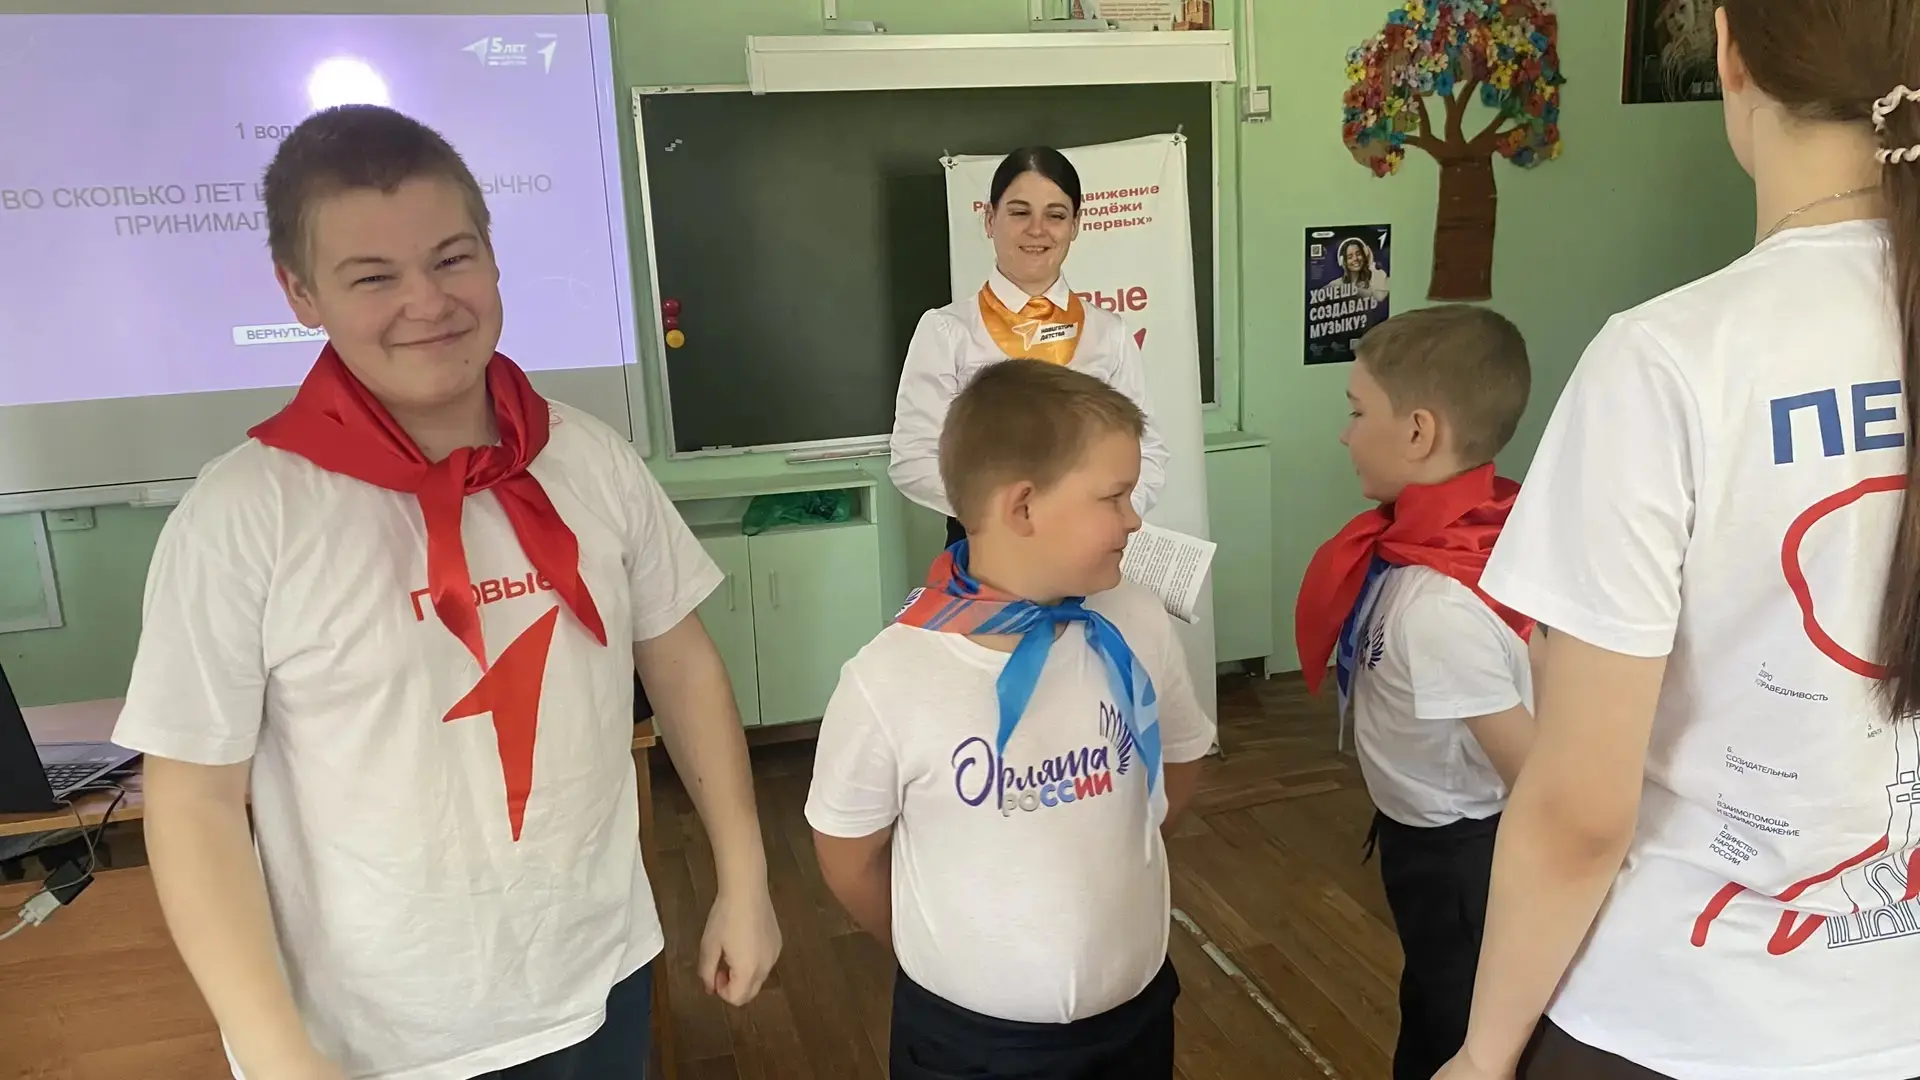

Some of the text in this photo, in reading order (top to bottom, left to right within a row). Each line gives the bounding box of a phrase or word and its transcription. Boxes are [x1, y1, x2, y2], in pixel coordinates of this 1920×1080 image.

[490, 36, 503, 53] 5
[236, 122, 246, 140] 1
[1, 189, 44, 210] ВО
[52, 183, 186, 209] СКОЛЬКО
[194, 182, 246, 204] ЛЕТ
[479, 173, 552, 195] ЫЧНО
[114, 210, 270, 236] ПРИНИМАЛ
[1079, 202, 1143, 221] лодёжи
[1082, 216, 1153, 232] первых»
[1309, 283, 1359, 305] ХОЧЕШЬ
[1309, 296, 1378, 322] СОЗДАВАТЬ
[1309, 314, 1368, 339] МУЗЫКУ?
[1725, 753, 1798, 780] СОЗИДАТЕЛЬНЫЙ
[1725, 760, 1744, 774] ТРУД
[1716, 800, 1789, 827] ВЗАИМОПОМОЩЬ
[1723, 810, 1800, 837] ВЗАИМОУВАЖЕНИЕ
[1708, 843, 1741, 867] РОССИИ
[1714, 836, 1750, 862] НАРОДОВ
[1719, 830, 1758, 857] ЕДИНСТВО
